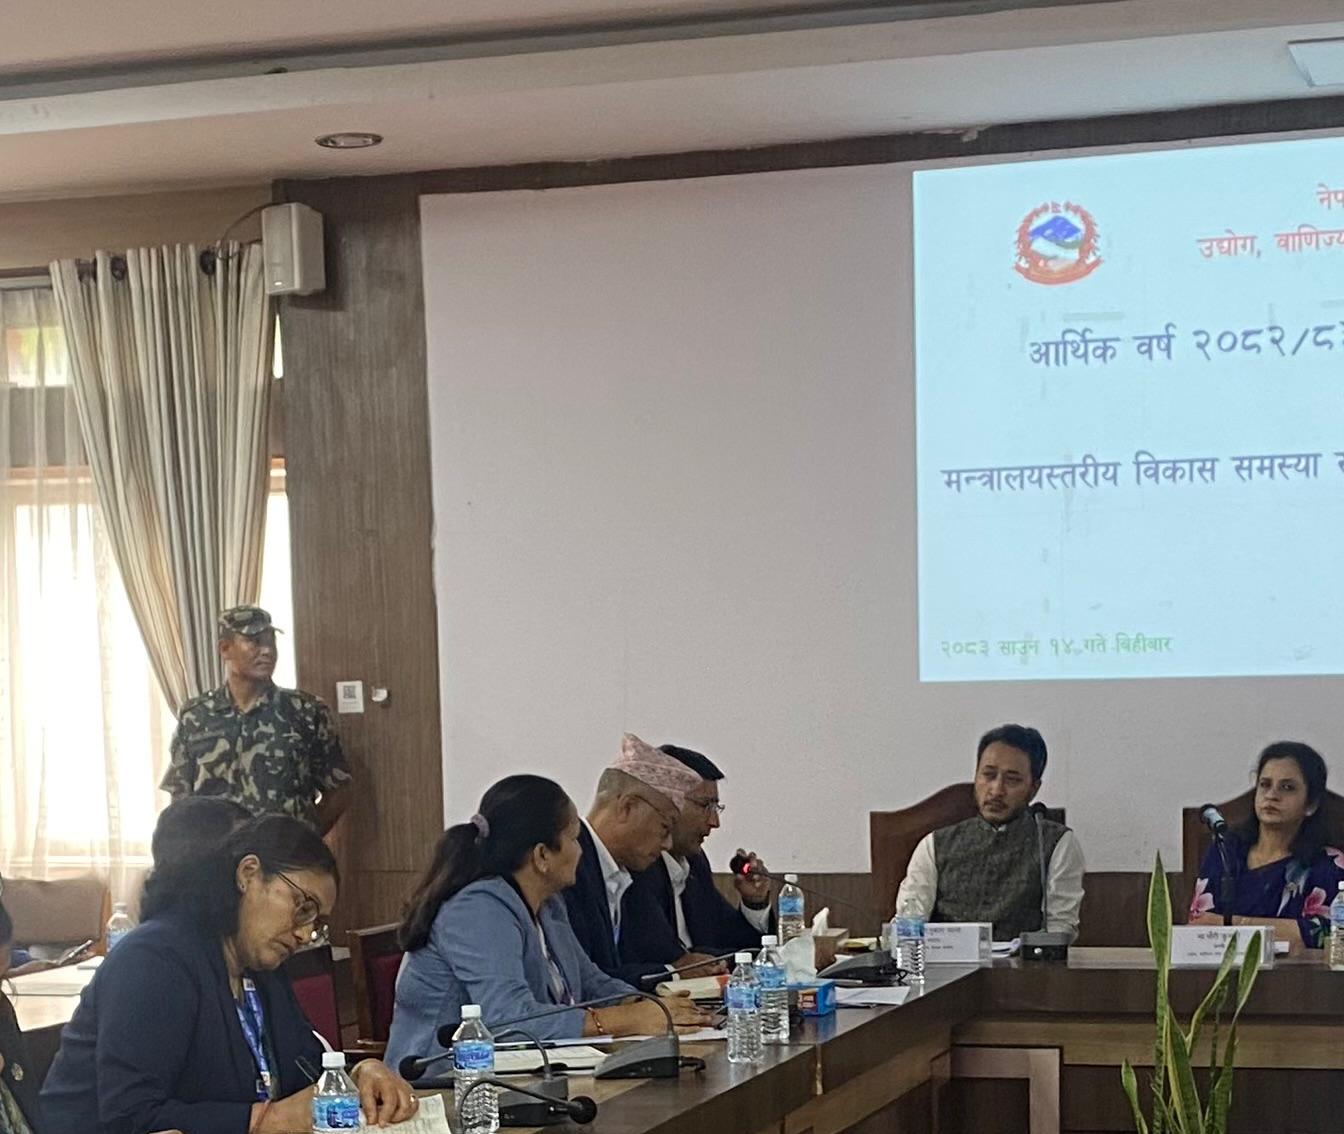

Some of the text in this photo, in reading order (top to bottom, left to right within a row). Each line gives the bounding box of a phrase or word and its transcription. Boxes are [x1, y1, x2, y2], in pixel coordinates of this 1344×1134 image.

[1030, 328, 1121, 366] आर्थिक
[1132, 323, 1176, 361] वर्ष
[940, 454, 1122, 493] मन्त्रालयस्तरीय
[1133, 450, 1219, 485] विकास
[1231, 453, 1322, 481] समस्या
[1083, 632, 1108, 653] गते
